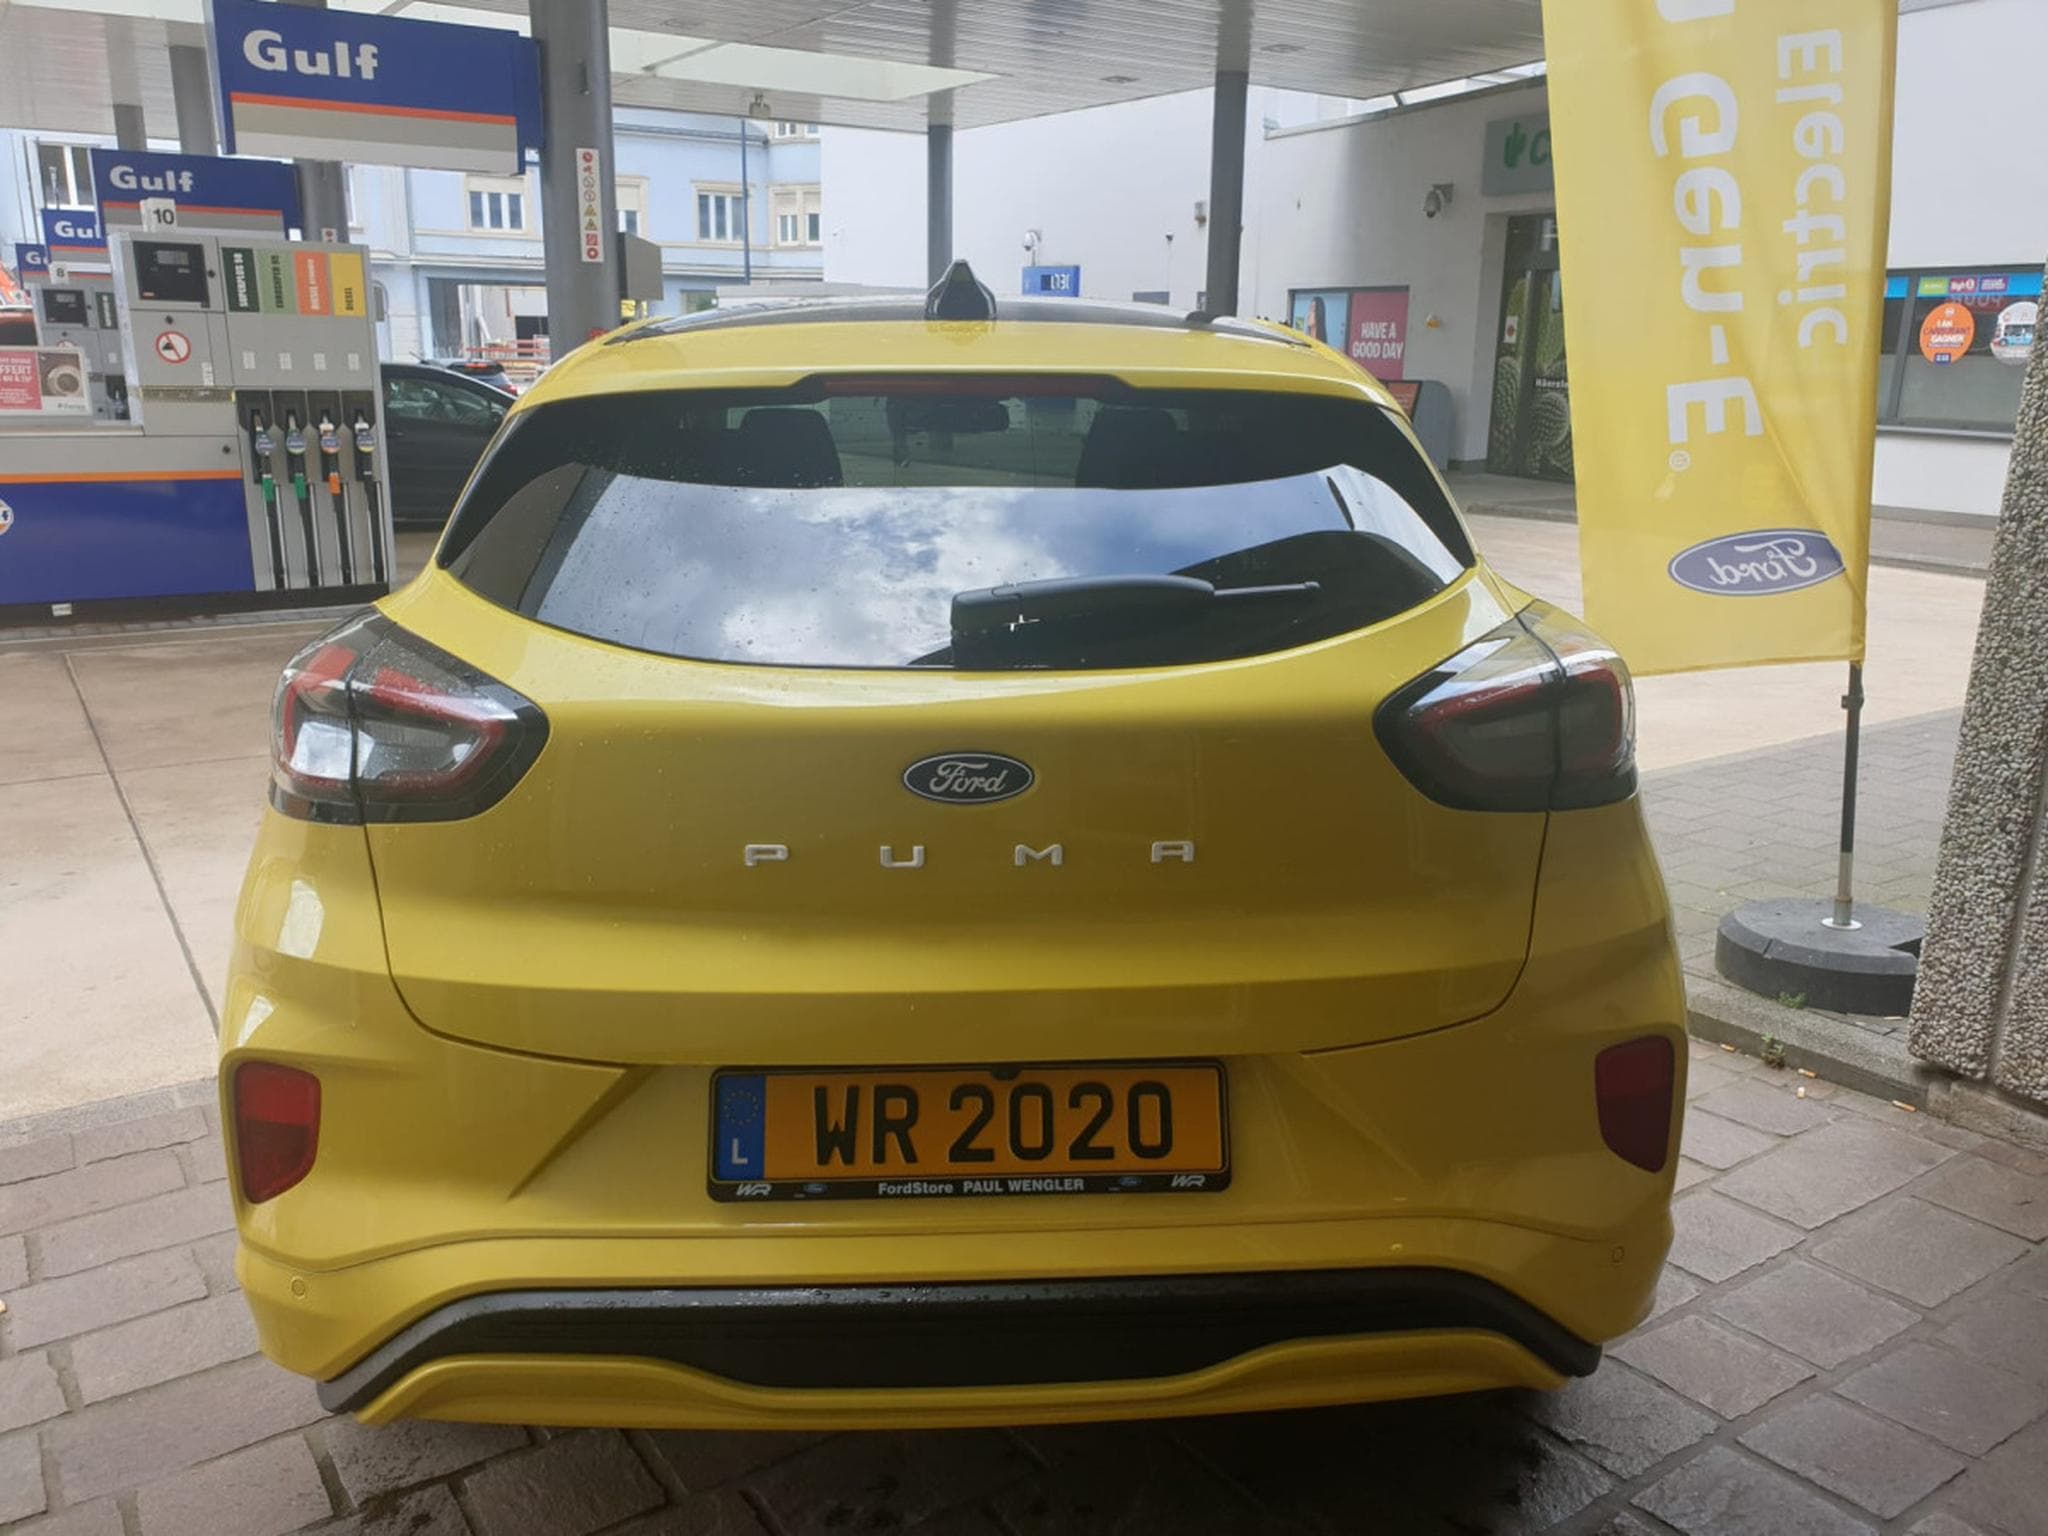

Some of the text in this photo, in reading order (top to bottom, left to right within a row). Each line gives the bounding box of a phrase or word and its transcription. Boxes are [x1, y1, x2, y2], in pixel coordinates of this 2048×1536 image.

[243, 29, 378, 80] Gulf
[109, 165, 194, 192] Gulf
[153, 208, 175, 225] 10
[344, 287, 355, 311] DIESEL
[1361, 321, 1396, 339] HAVE A
[1352, 341, 1404, 360] GOOD DAY
[929, 760, 1009, 792] Ford
[744, 840, 1195, 868] PUMA
[814, 1080, 1173, 1165] WR 2020
[731, 1137, 748, 1165] L
[877, 1177, 1085, 1196] FordStore PAUL WENGLER
